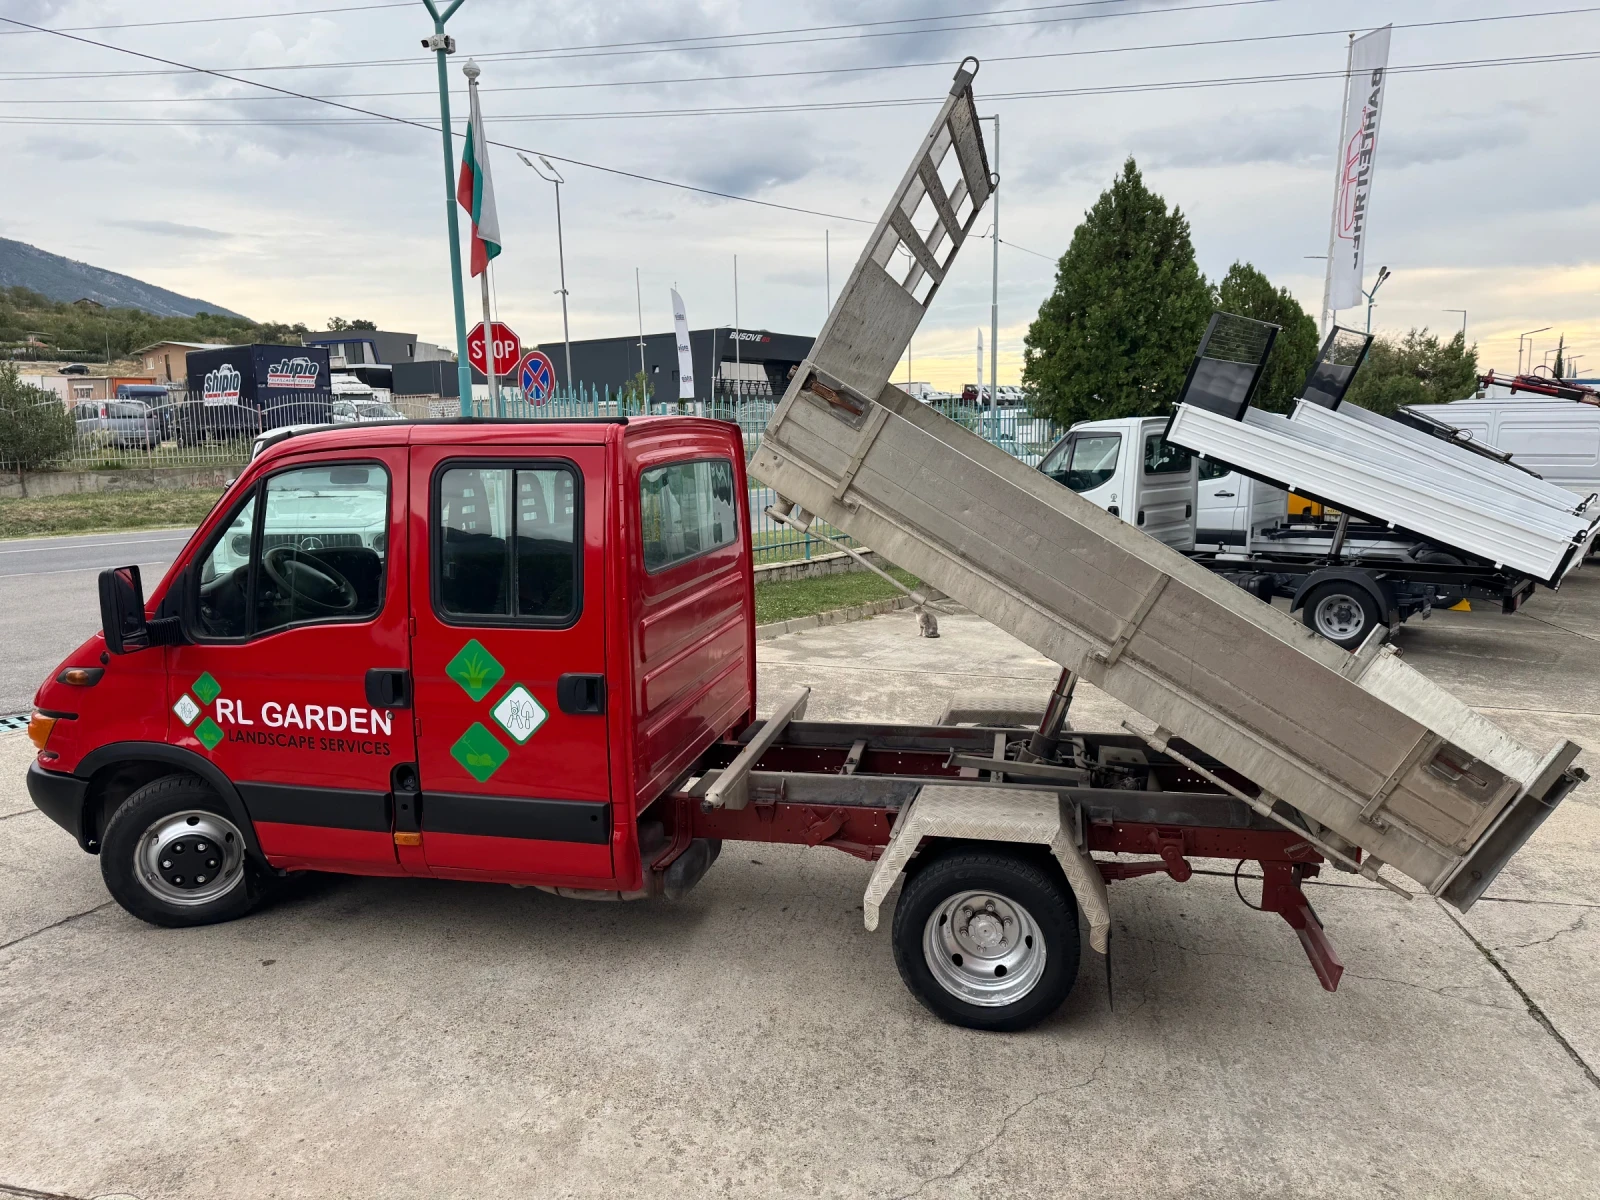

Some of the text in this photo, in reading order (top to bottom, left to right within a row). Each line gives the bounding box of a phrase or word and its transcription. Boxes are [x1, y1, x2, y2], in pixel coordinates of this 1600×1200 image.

[471, 340, 515, 359] SOP
[215, 698, 392, 736] RL GARDEN
[228, 730, 391, 756] LANDSCAPE SERVICES
